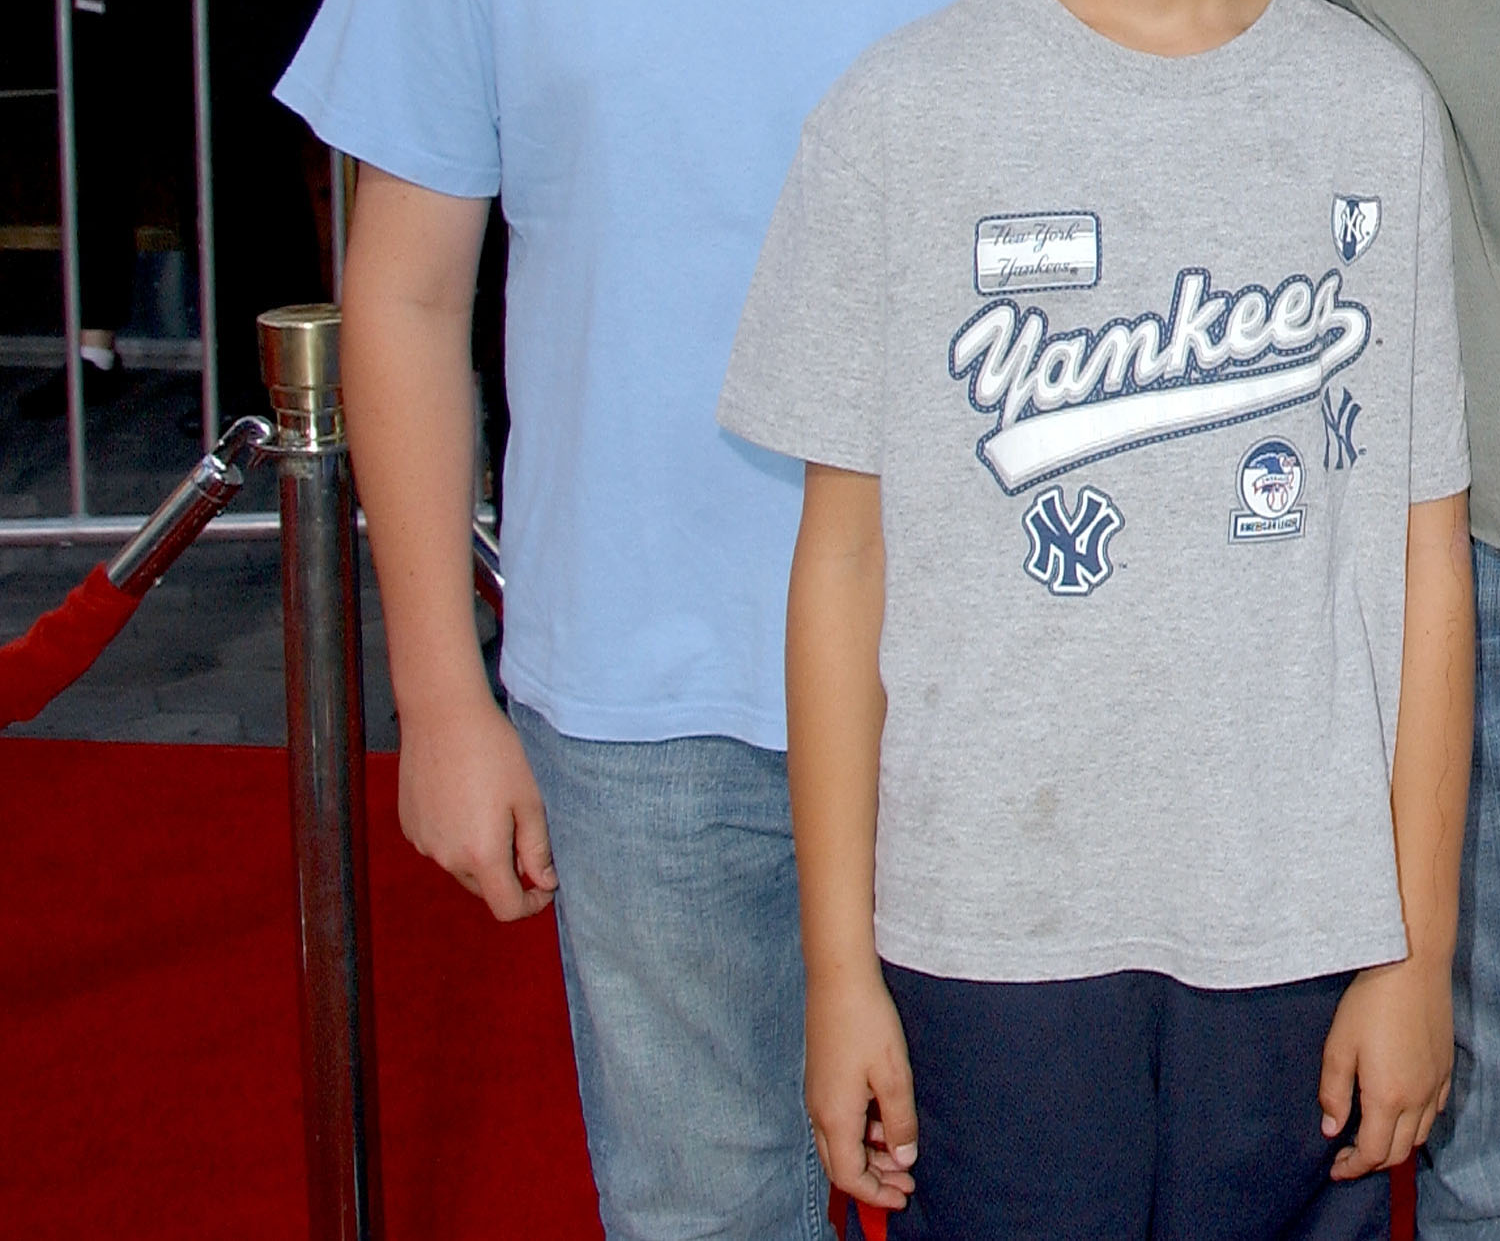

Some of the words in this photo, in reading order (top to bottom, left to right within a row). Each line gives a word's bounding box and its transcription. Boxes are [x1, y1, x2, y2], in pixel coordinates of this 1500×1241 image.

[991, 224, 1032, 246] New
[1033, 222, 1080, 253] York
[998, 255, 1070, 287] Yankees
[949, 267, 1371, 496] Yankees
[1022, 485, 1126, 597] NY
